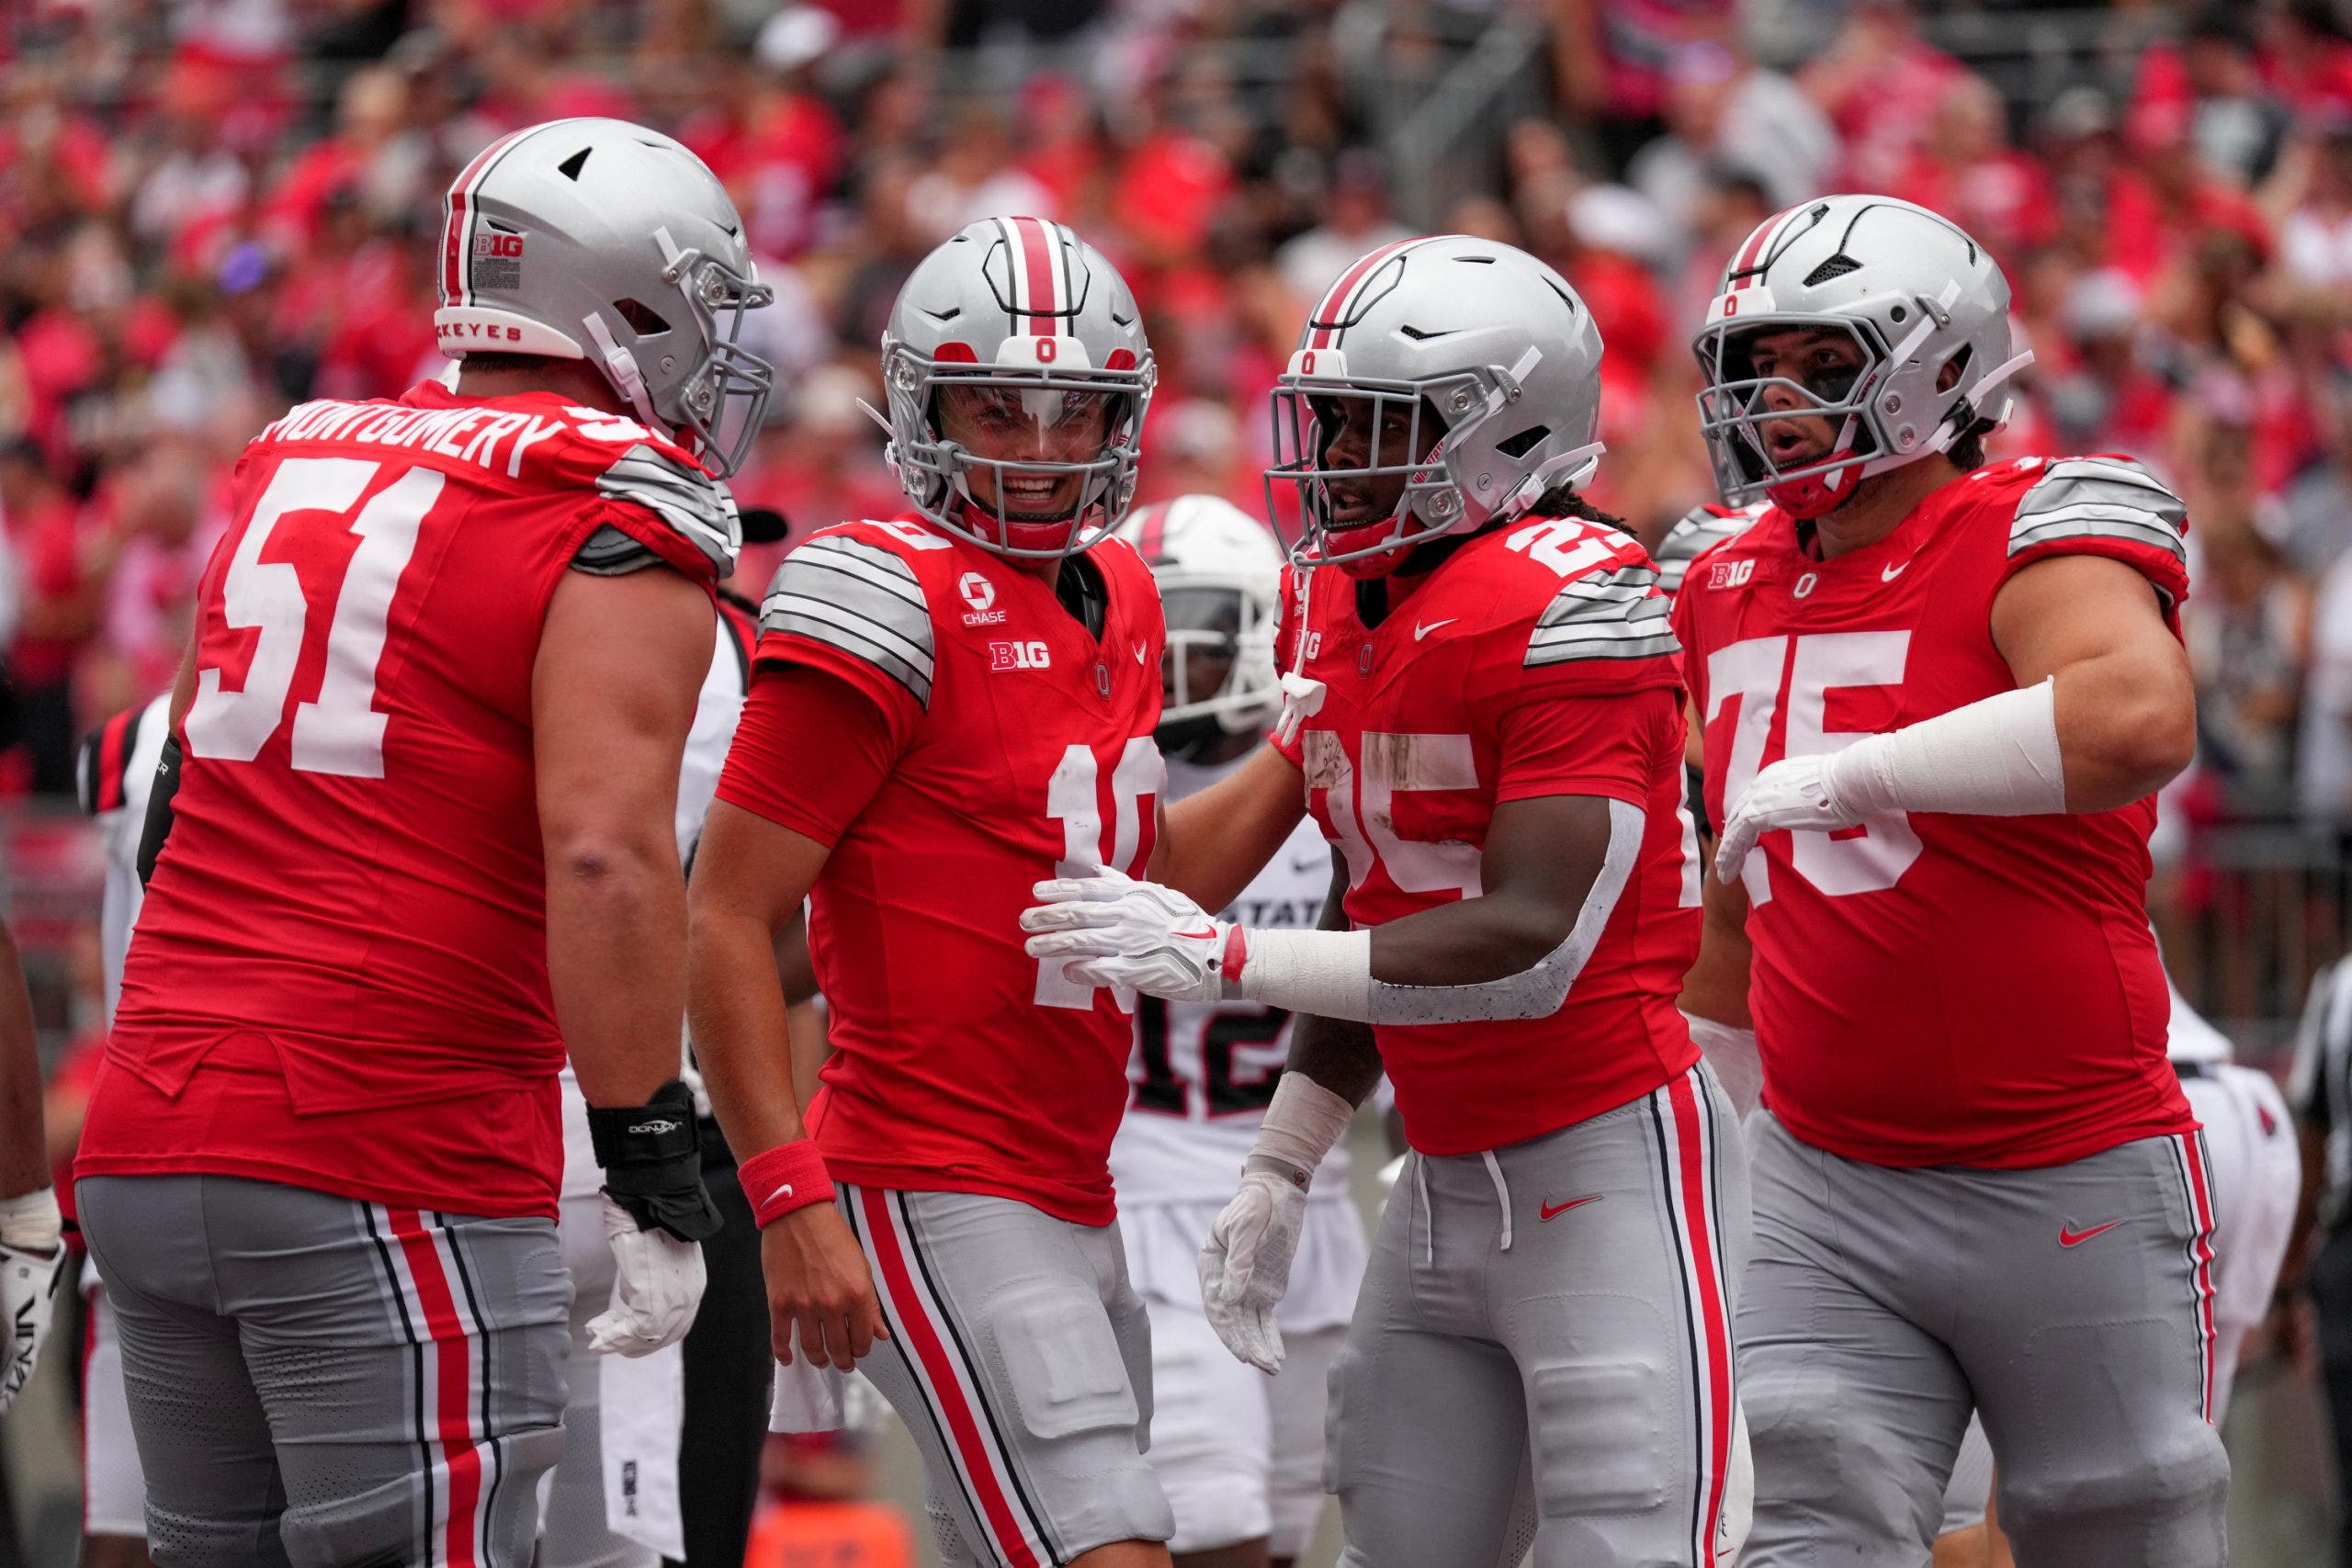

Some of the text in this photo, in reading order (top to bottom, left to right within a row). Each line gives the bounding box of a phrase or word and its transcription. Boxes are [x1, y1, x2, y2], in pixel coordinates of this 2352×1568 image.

[258, 398, 567, 478] MONTGOMERY
[185, 457, 445, 779] 51
[963, 611, 1006, 626] CHASE
[1131, 990, 1294, 1122] 12
